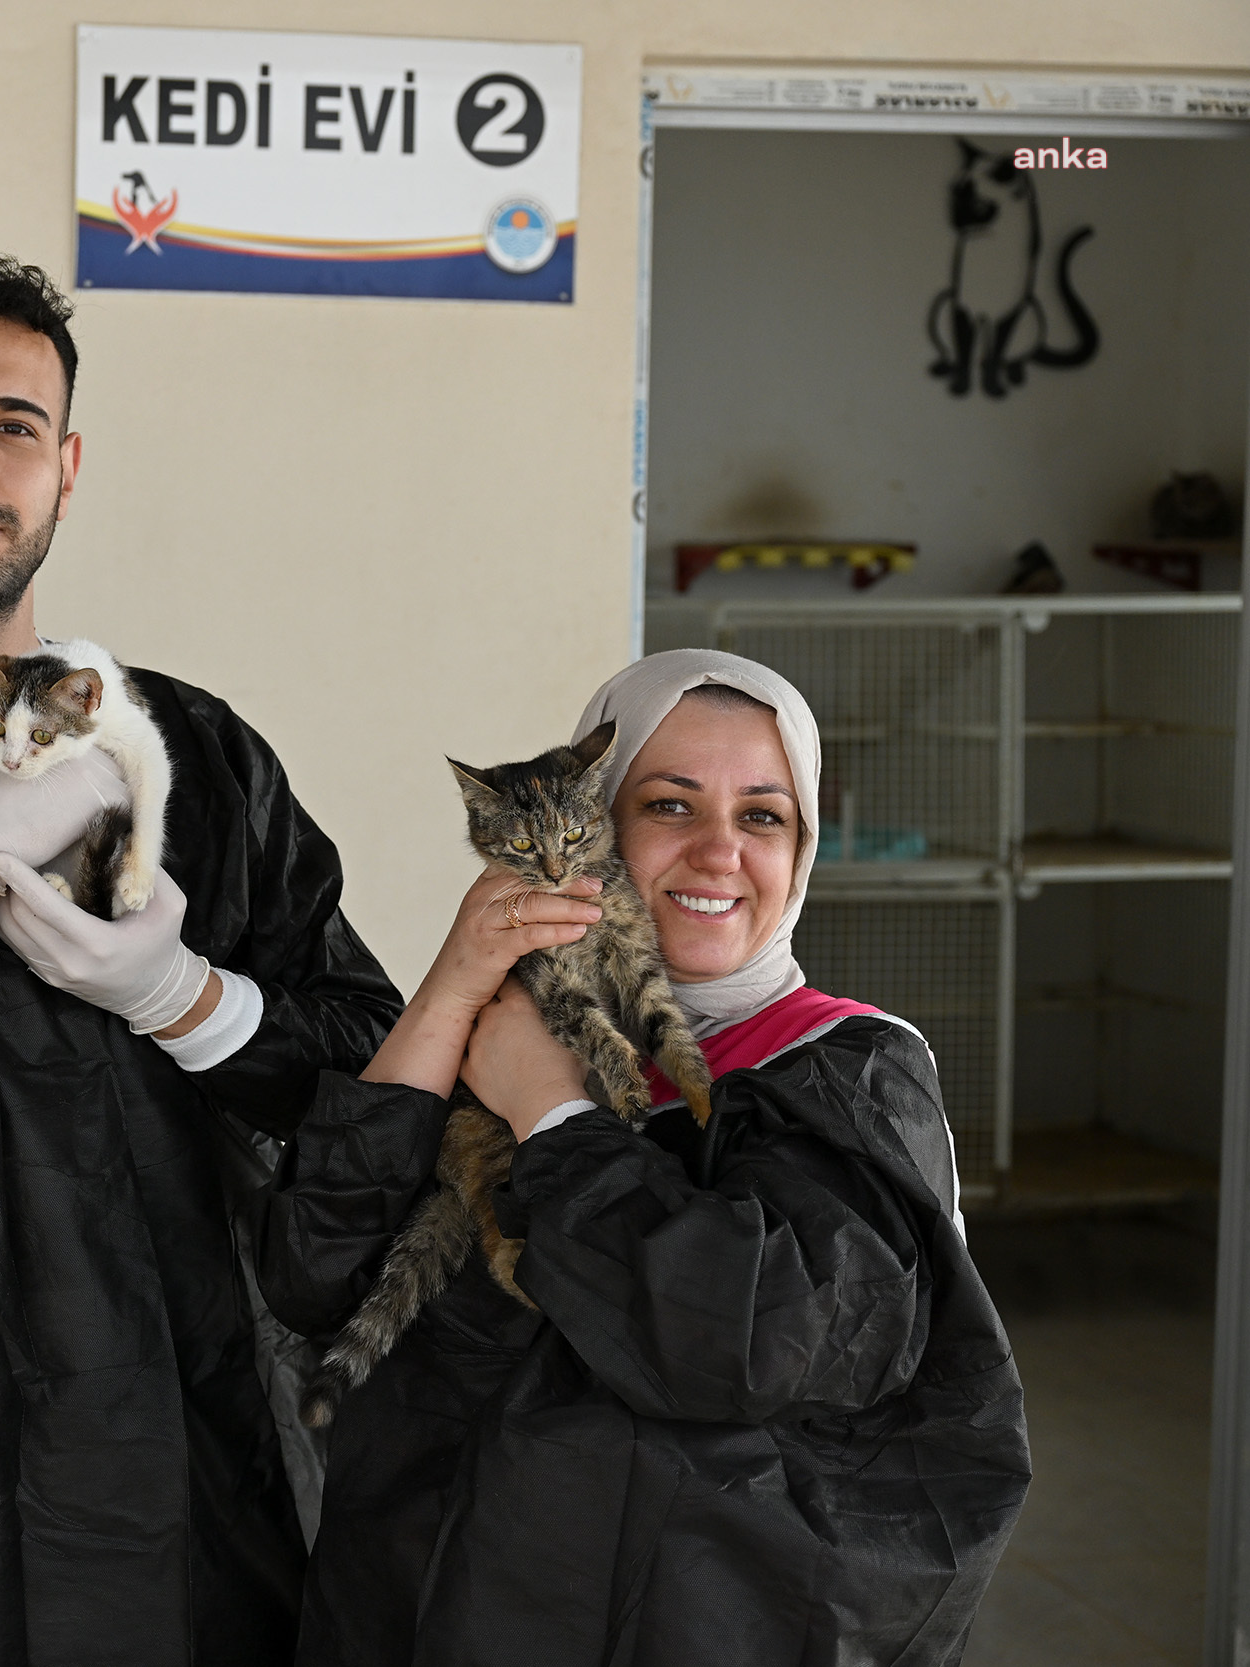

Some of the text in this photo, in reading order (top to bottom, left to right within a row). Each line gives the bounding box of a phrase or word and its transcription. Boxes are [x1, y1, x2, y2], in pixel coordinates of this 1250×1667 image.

[102, 63, 528, 154] KEDİ EVİ 2
